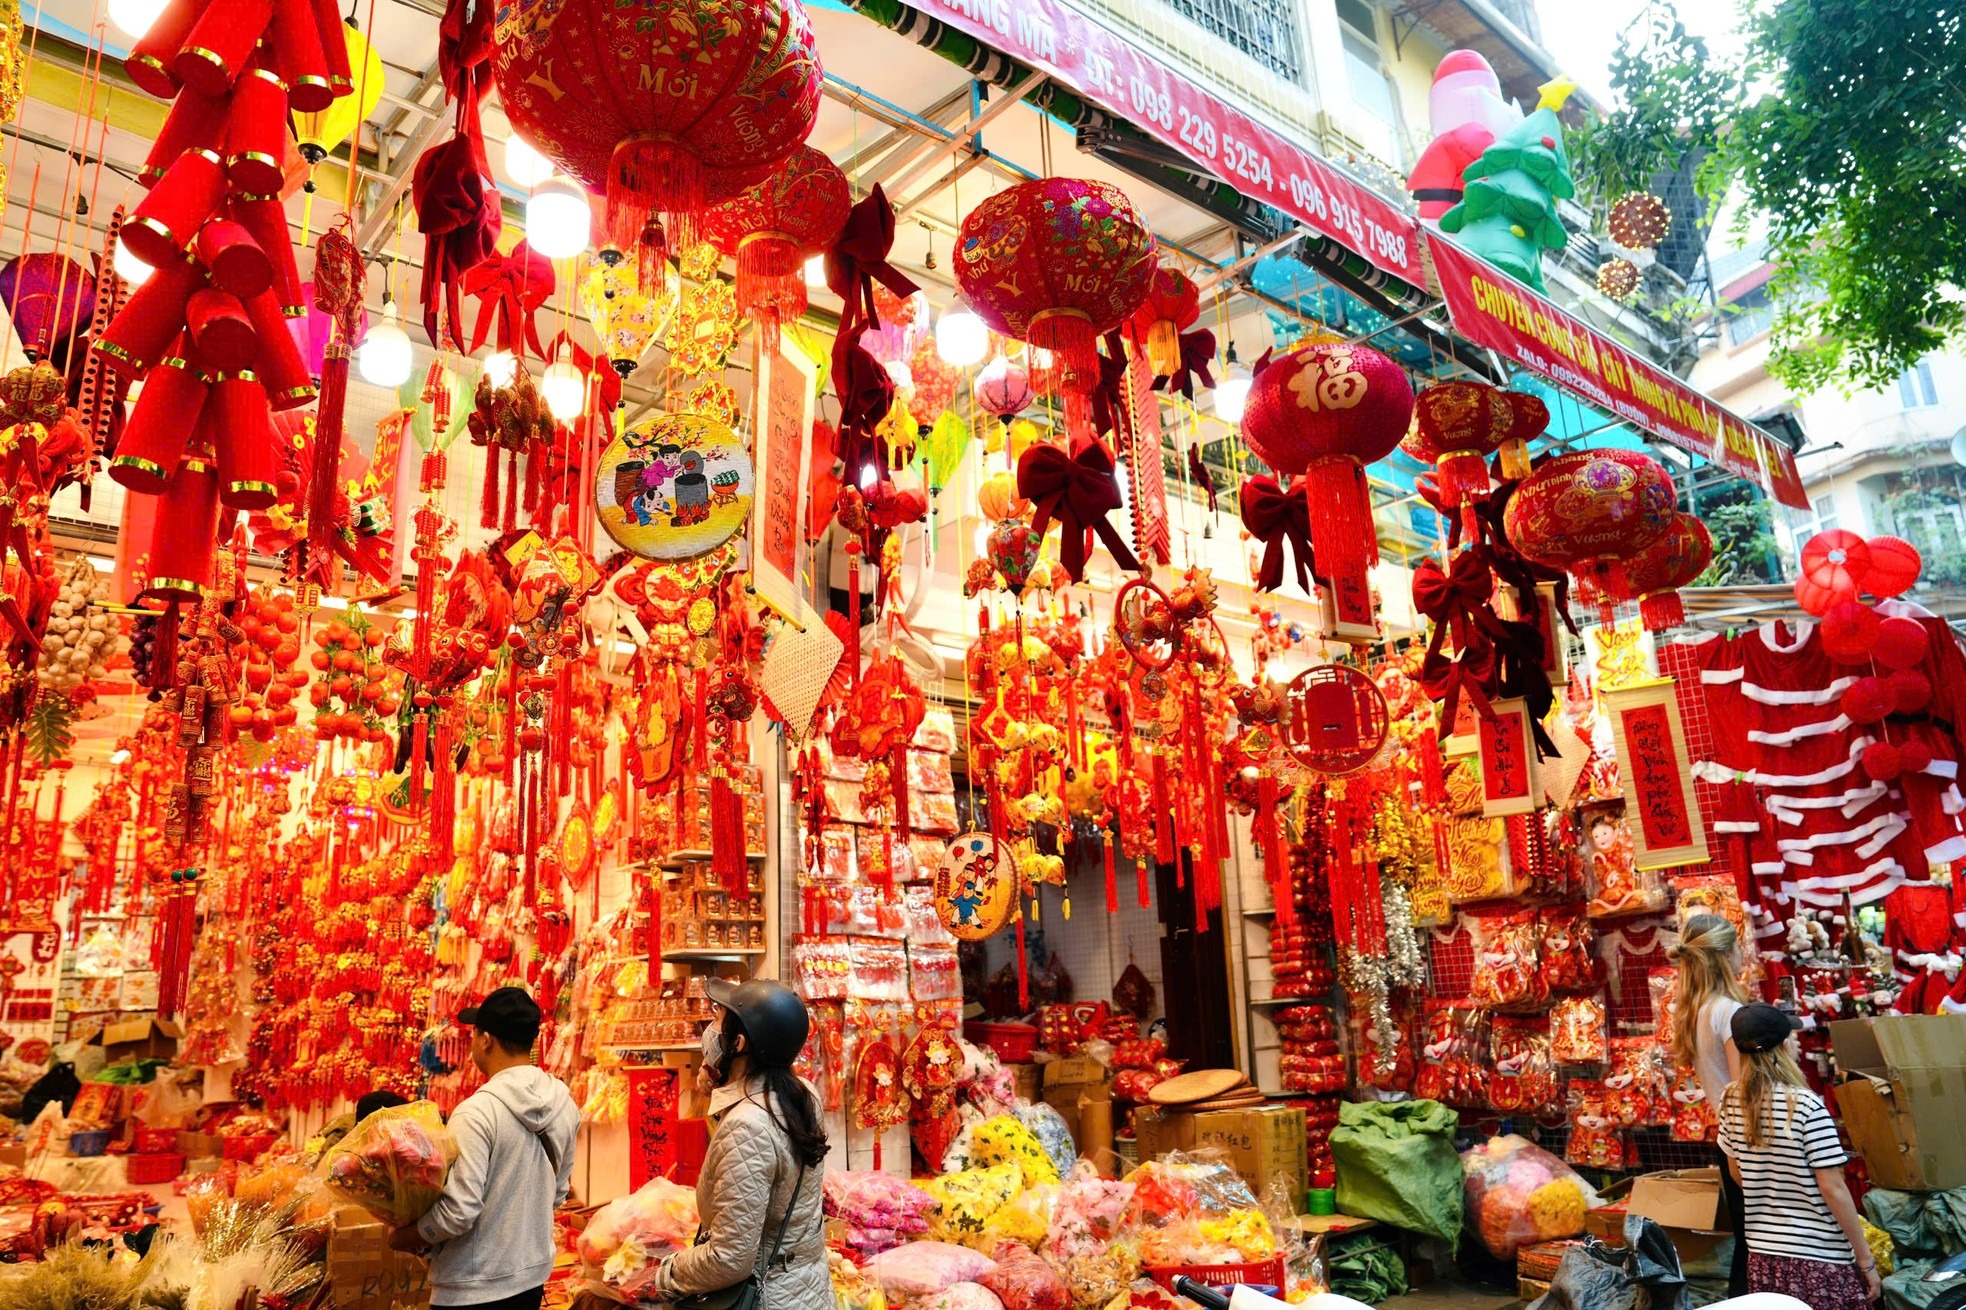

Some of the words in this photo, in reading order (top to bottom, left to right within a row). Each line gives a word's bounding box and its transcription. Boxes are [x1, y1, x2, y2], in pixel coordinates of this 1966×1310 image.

[525, 54, 567, 102] Ý
[636, 63, 700, 101] Mới
[1015, 7, 1058, 65] MÃ
[1130, 76, 1173, 132] 098
[1178, 106, 1217, 160] 229
[1222, 132, 1274, 193] 5254
[1278, 180, 1287, 192] -
[1290, 172, 1328, 221] 096
[1330, 195, 1365, 244] 915
[1364, 218, 1409, 270] 7988
[994, 268, 1025, 298] Ý
[1064, 272, 1101, 294] Mới
[1471, 275, 1537, 338] CHUYÊN
[1601, 351, 1628, 392] CÂY
[1515, 343, 1549, 374] ZALO:
[1287, 348, 1369, 413] 福
